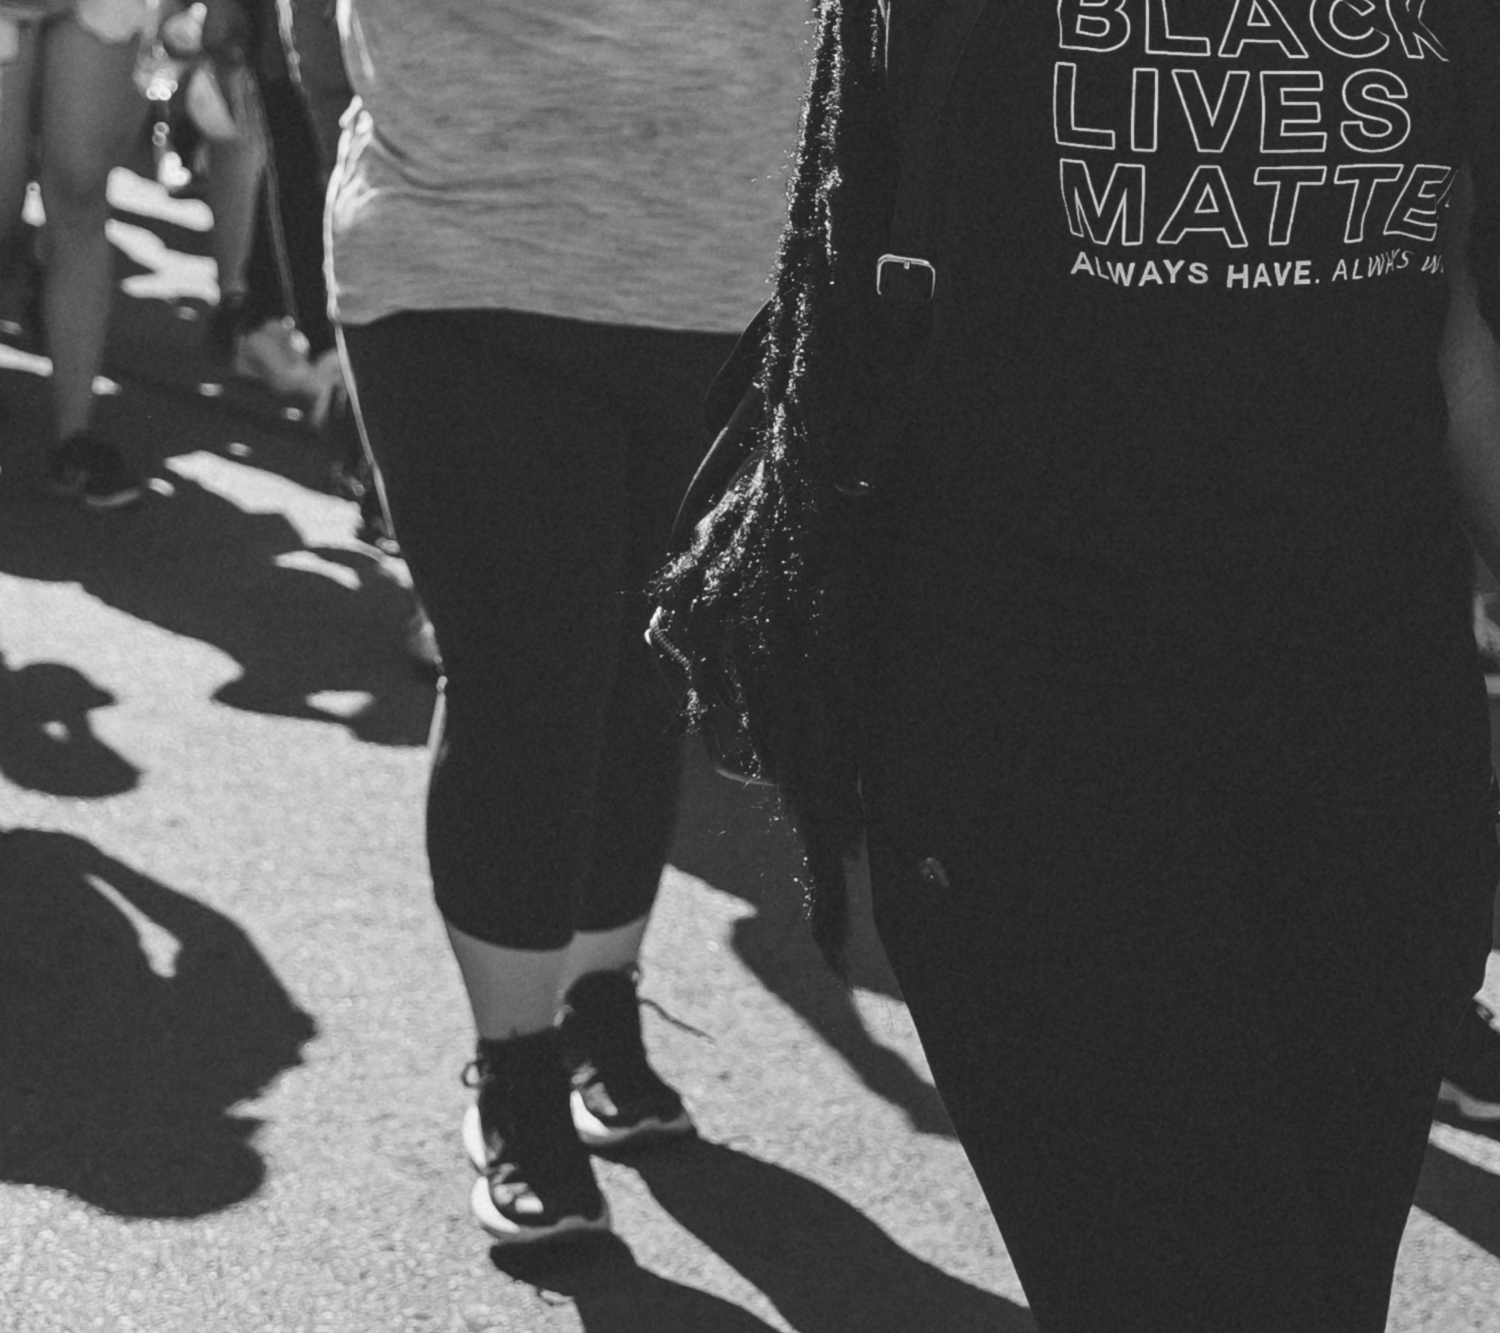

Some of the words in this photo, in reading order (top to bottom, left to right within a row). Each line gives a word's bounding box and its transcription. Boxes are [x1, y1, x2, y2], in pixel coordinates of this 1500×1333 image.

[1052, 61, 1412, 154] LIVES
[1071, 249, 1210, 288] ALWAYS
[1226, 259, 1321, 290] HAVE.
[1331, 247, 1415, 283] ALWAYS
